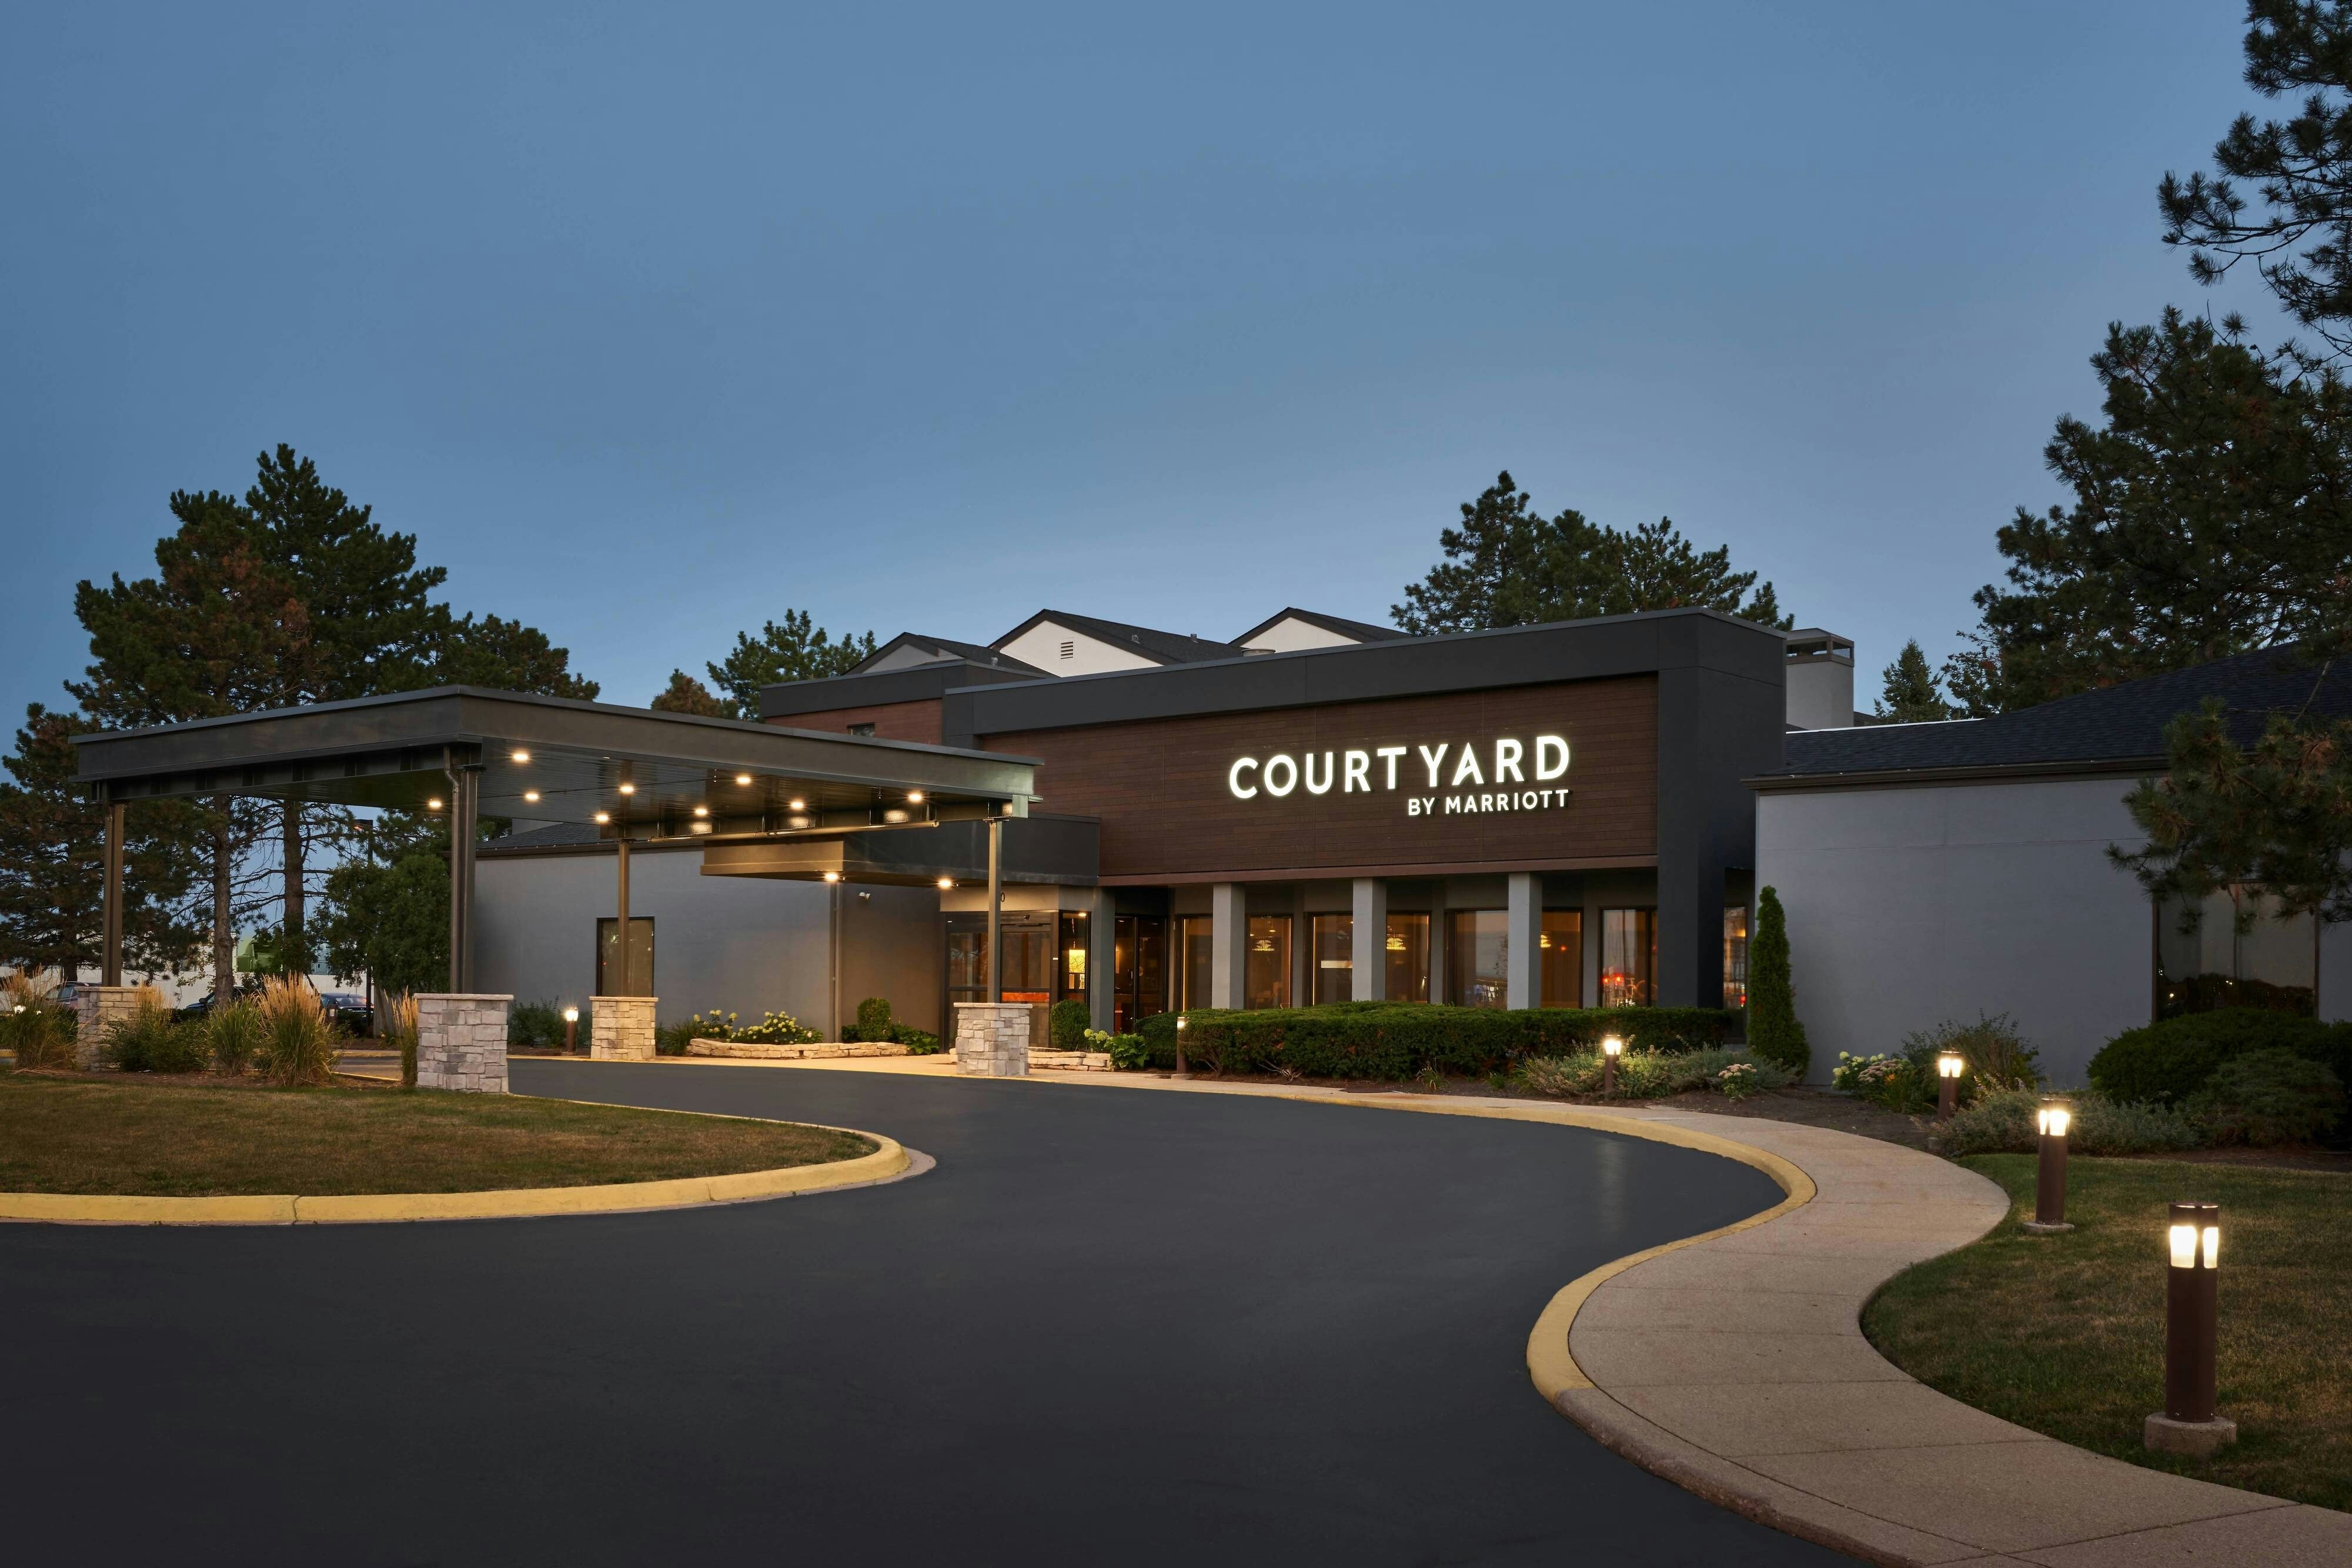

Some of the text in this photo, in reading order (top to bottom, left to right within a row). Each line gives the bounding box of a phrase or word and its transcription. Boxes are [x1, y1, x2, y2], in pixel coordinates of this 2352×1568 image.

[1229, 735, 1570, 800] COURTYARD
[1408, 789, 1569, 817] BY MARRIOTT
